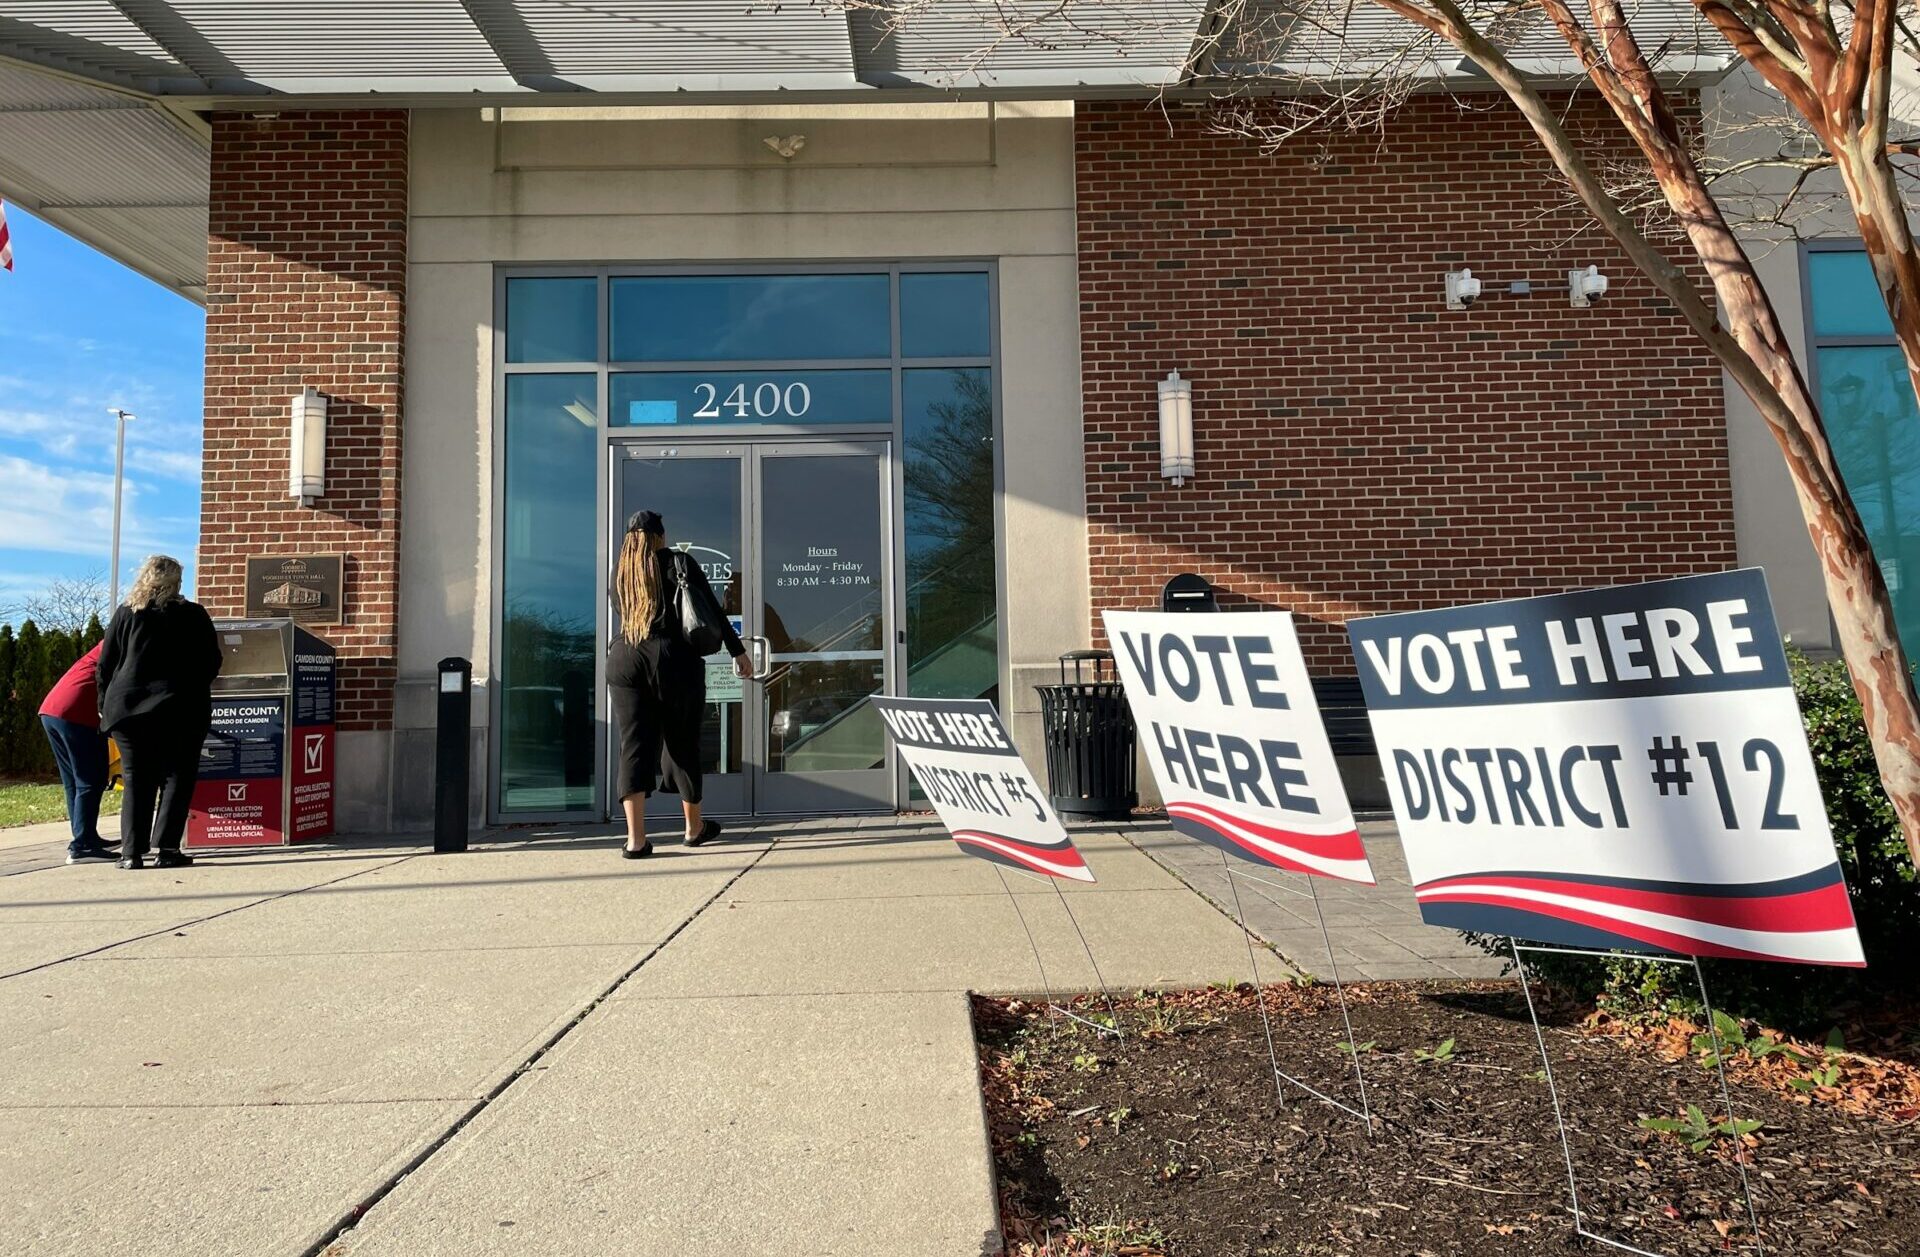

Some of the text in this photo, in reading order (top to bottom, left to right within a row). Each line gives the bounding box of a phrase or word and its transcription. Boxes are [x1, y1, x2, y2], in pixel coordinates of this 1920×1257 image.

[693, 382, 811, 418] 2400
[782, 562, 822, 574] Monday
[832, 562, 863, 574] Friday
[808, 547, 837, 556] Hours
[777, 577, 800, 587] 8:30
[802, 576, 820, 586] AM
[830, 576, 852, 586] 4:30
[854, 575, 870, 584] PM
[295, 655, 334, 664] CAMDEN COUNTY
[1362, 599, 1763, 696] VOTE HERE
[1120, 631, 1290, 710] VOTE
[238, 706, 280, 716] COUNTY
[879, 708, 1008, 749] VOTE HERE
[1152, 721, 1320, 814] HERE
[1393, 736, 1801, 830] DISTRICT #12
[914, 762, 1047, 822] DISTRICT #5
